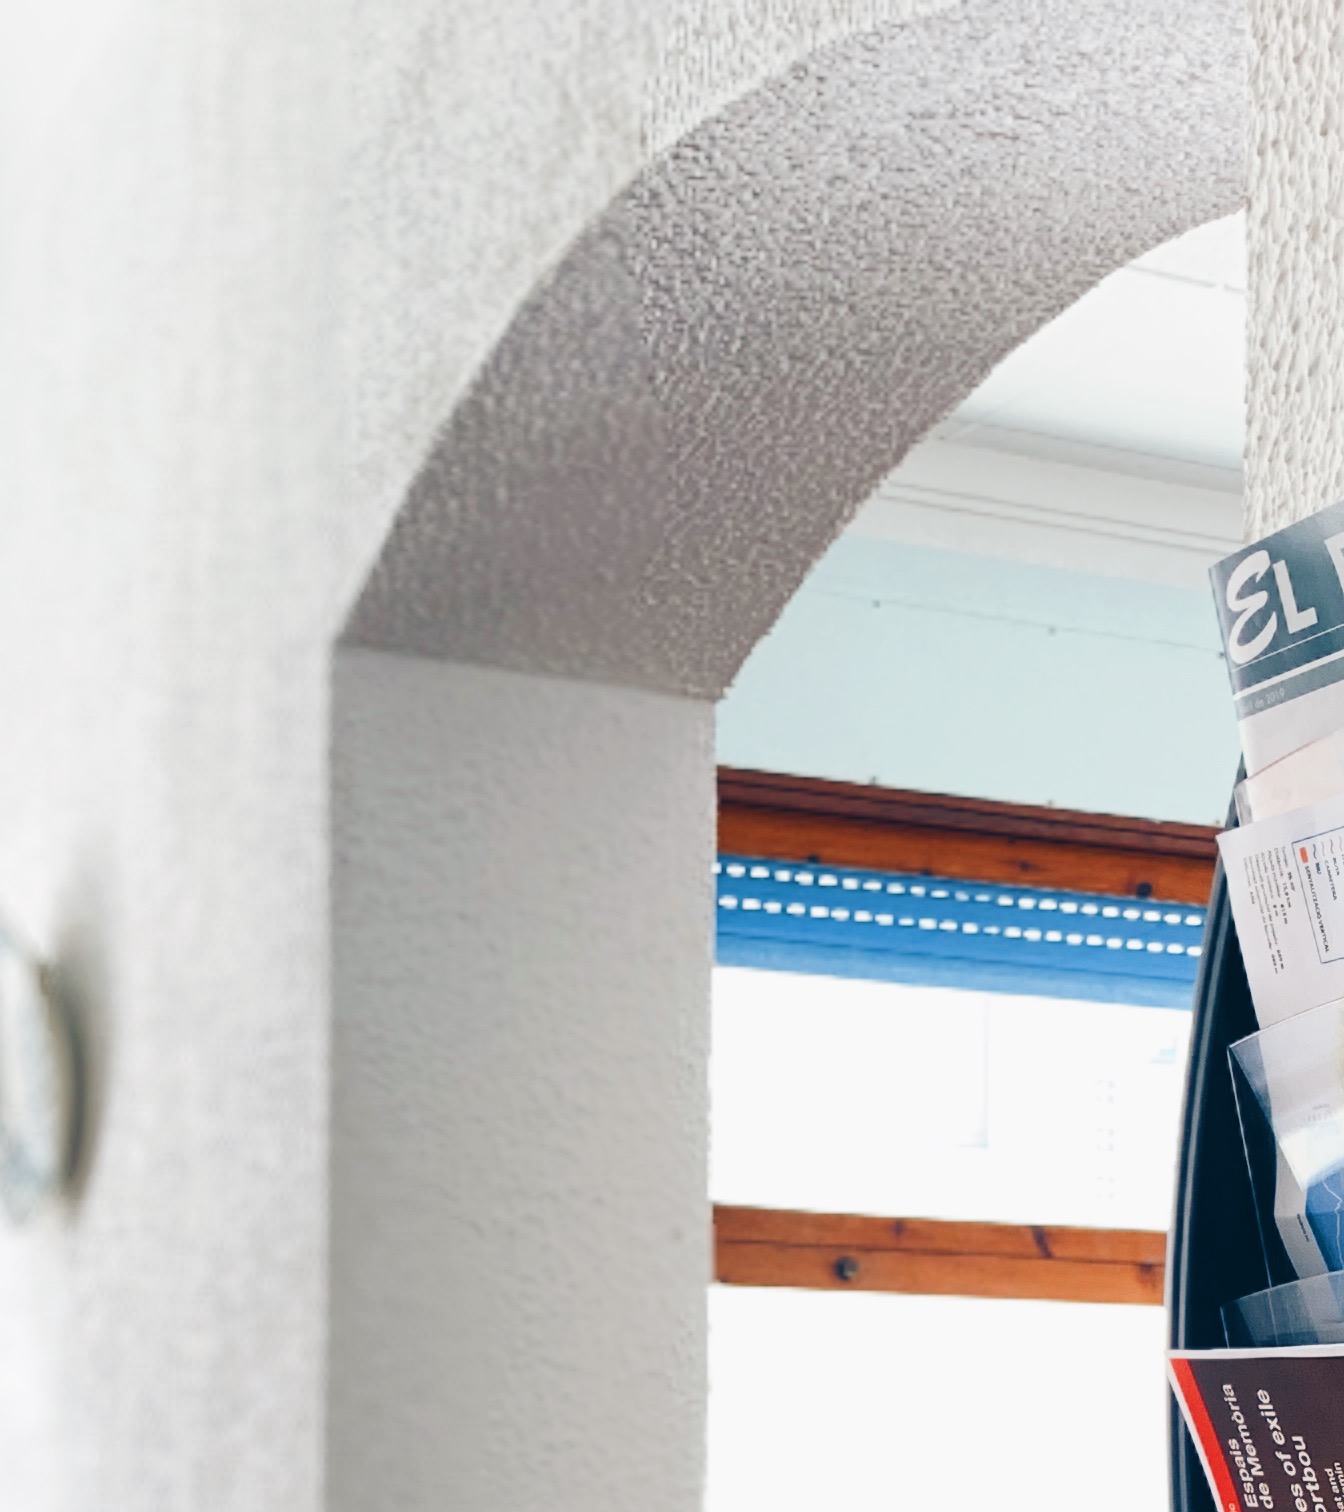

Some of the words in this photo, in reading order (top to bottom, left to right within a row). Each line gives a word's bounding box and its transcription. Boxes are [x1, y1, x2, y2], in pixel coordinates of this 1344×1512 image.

[1226, 549, 1318, 666] EL
[1315, 919, 1331, 953] VERTICAL
[1222, 1384, 1264, 1476] Memòria
[1257, 1389, 1285, 1445] exile
[1228, 1438, 1258, 1508] Espais
[1275, 1451, 1296, 1476] of
[1324, 1468, 1340, 1493] and
[1258, 1483, 1274, 1509] de
